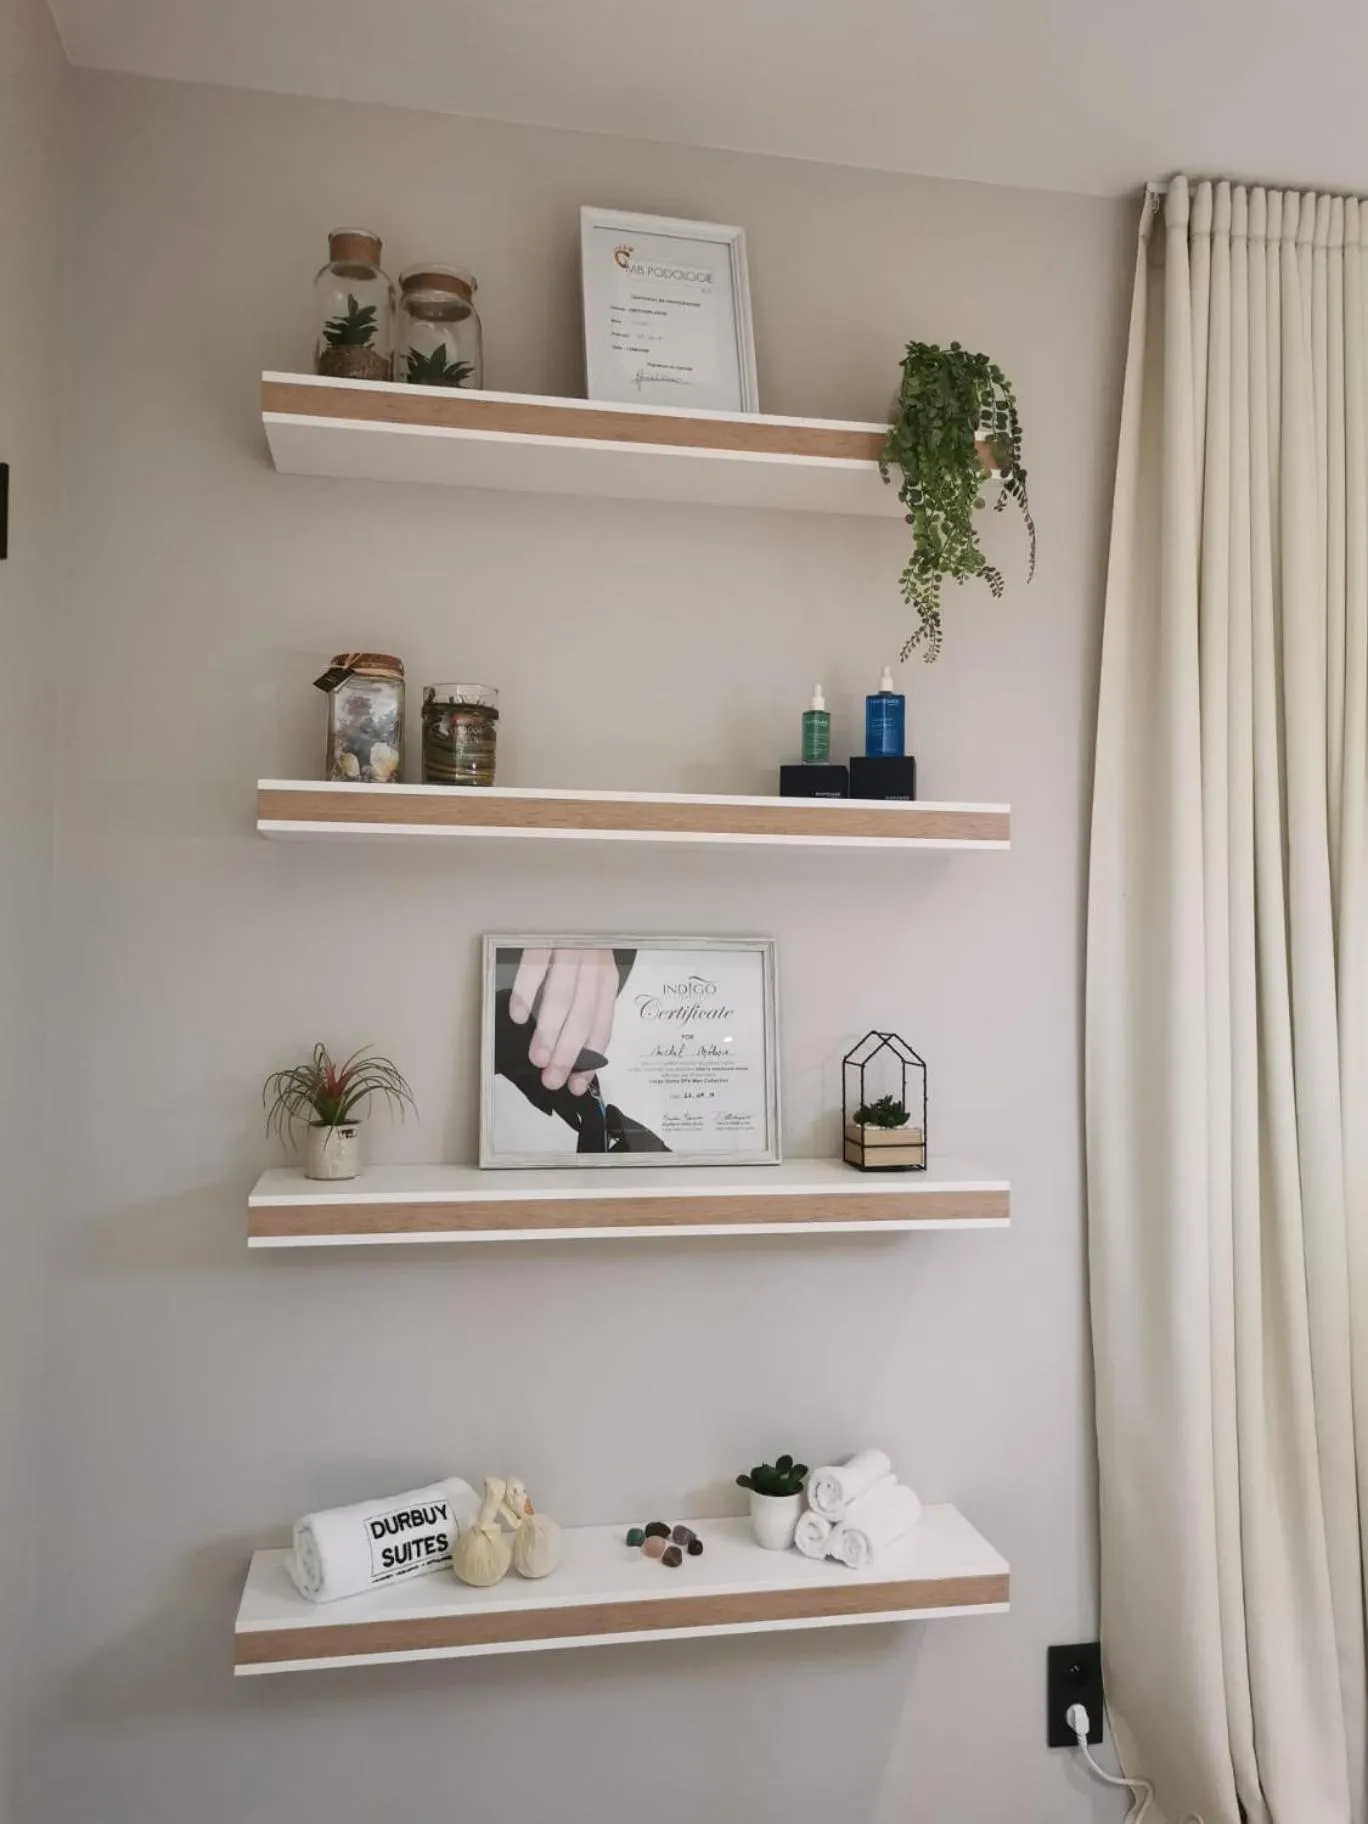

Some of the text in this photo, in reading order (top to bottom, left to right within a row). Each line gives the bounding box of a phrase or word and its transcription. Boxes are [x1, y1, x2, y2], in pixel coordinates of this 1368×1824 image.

[663, 981, 717, 996] INDIGO
[635, 994, 735, 1025] Certificate
[370, 1504, 448, 1539] DURBUY
[381, 1533, 449, 1568] SUITES
